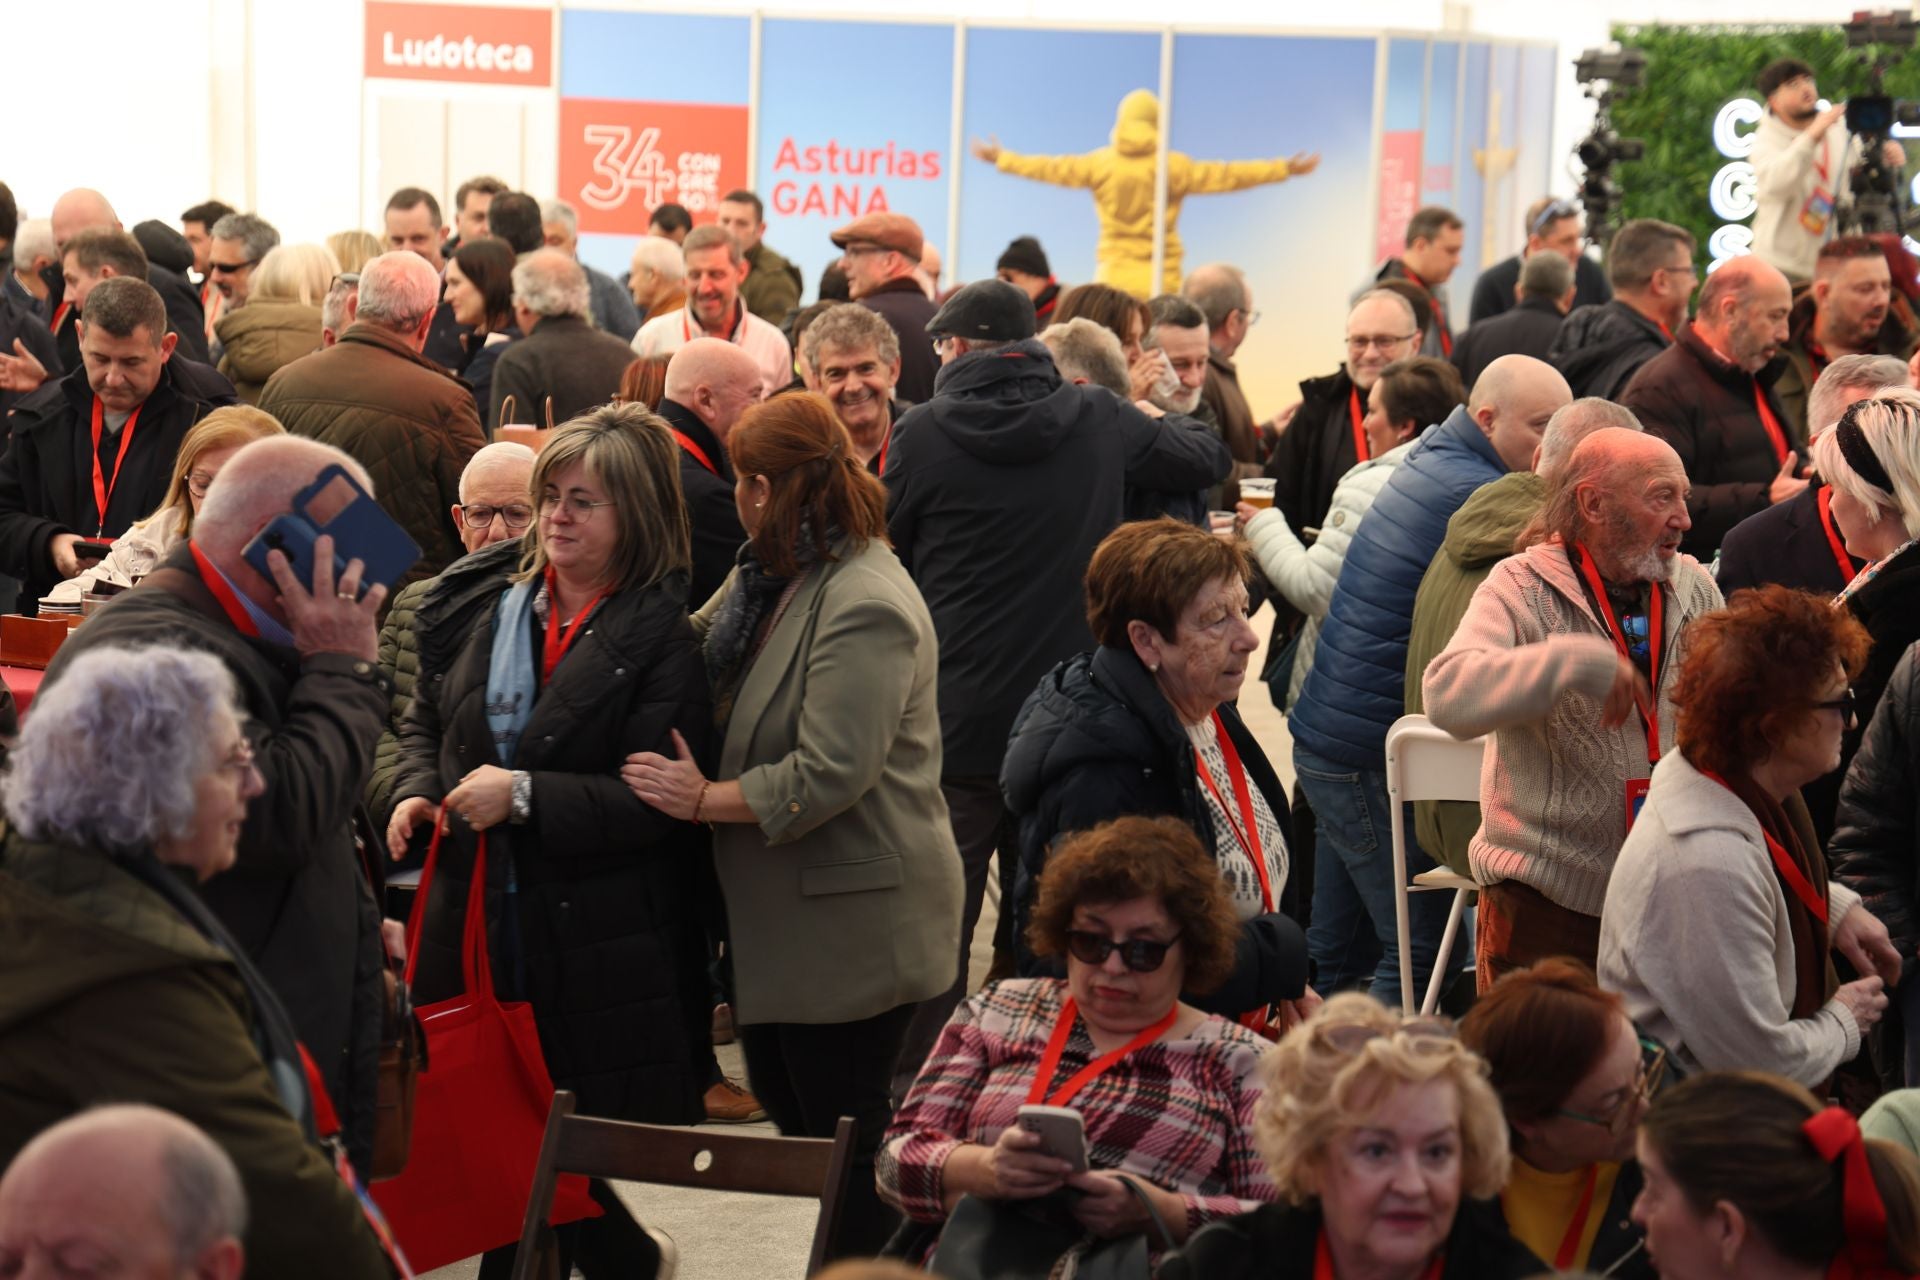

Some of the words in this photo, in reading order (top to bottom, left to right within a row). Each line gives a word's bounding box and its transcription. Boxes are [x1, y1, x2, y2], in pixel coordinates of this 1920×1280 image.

[383, 31, 534, 73] Ludoteca
[580, 124, 677, 213] 34
[677, 152, 721, 172] CON
[773, 135, 942, 181] Asturias
[771, 179, 890, 218] GANA
